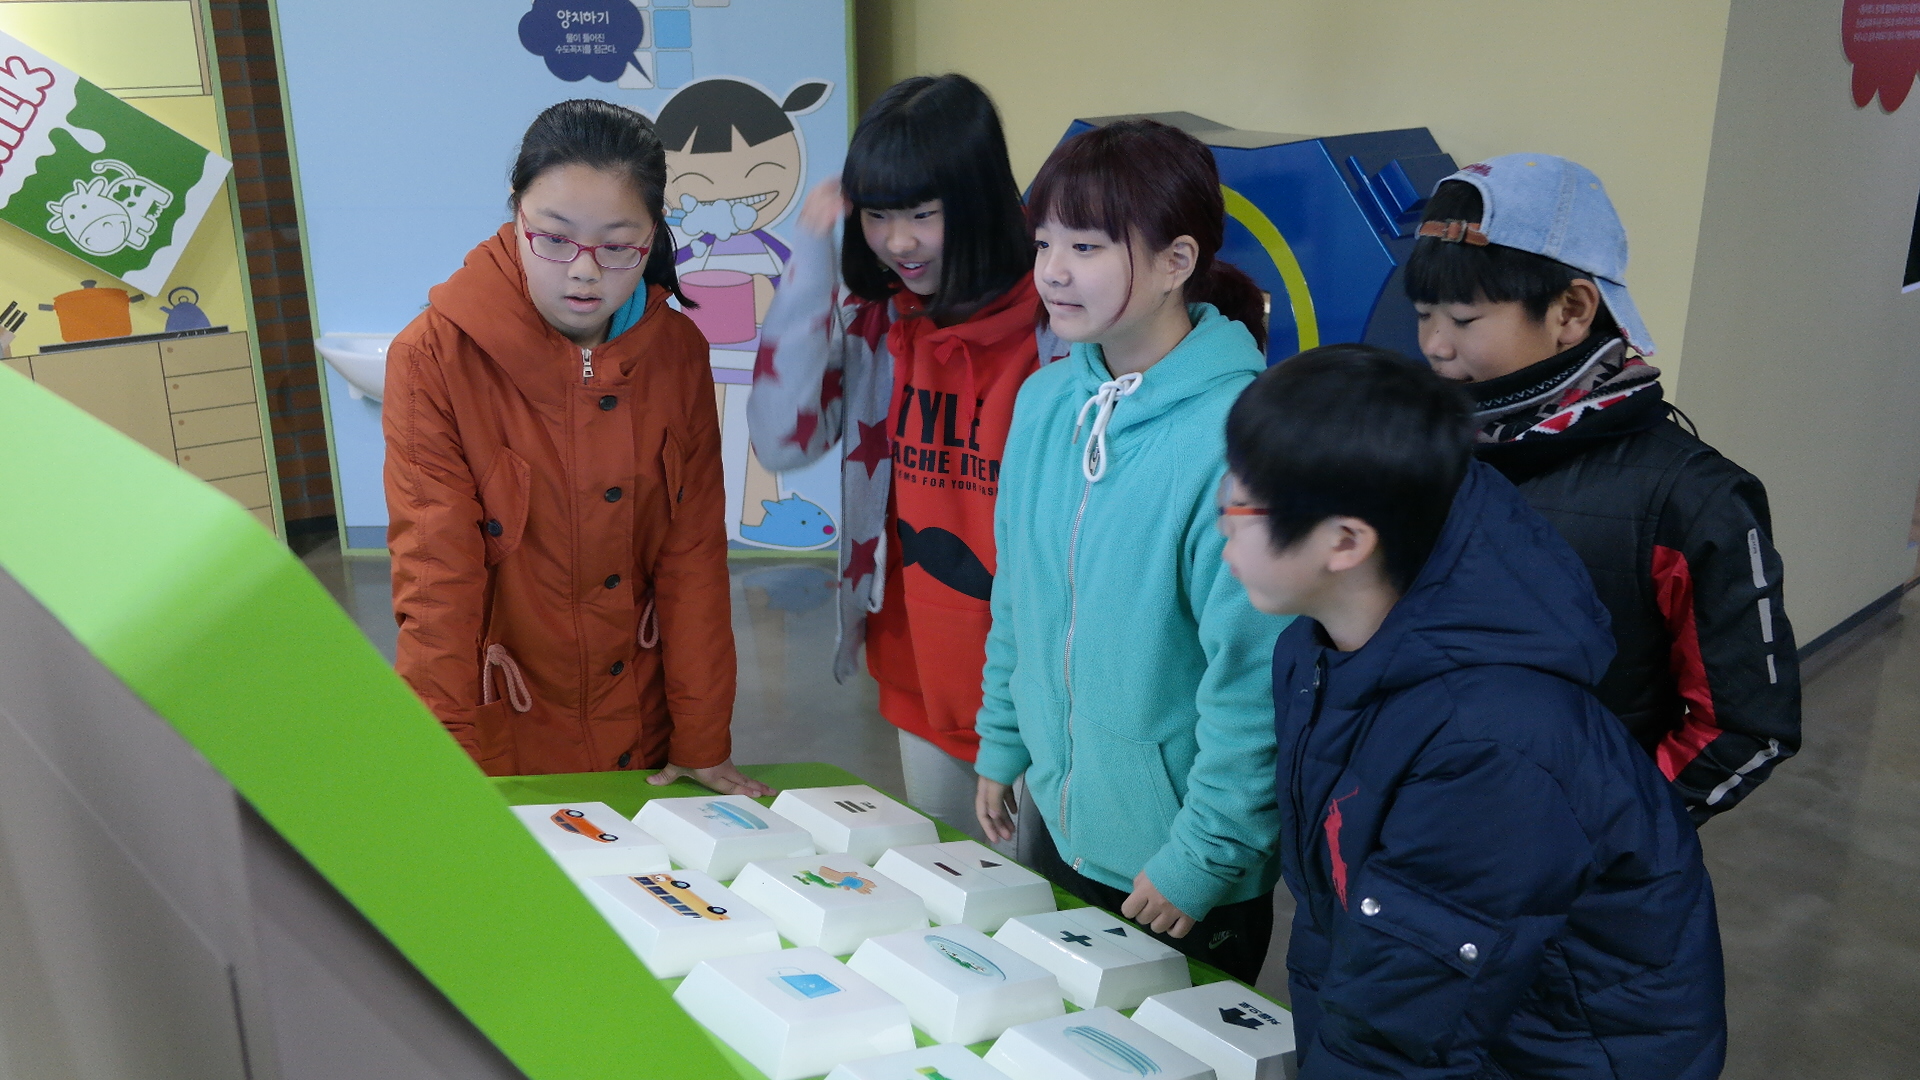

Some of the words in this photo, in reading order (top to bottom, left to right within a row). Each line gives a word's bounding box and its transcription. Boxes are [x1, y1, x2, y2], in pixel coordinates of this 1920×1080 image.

[557, 10, 609, 29] 양치하기
[566, 33, 581, 43] 물이
[555, 45, 591, 54] 수도꼭지를
[922, 477, 945, 488] FOR
[951, 480, 976, 491] YOUR
